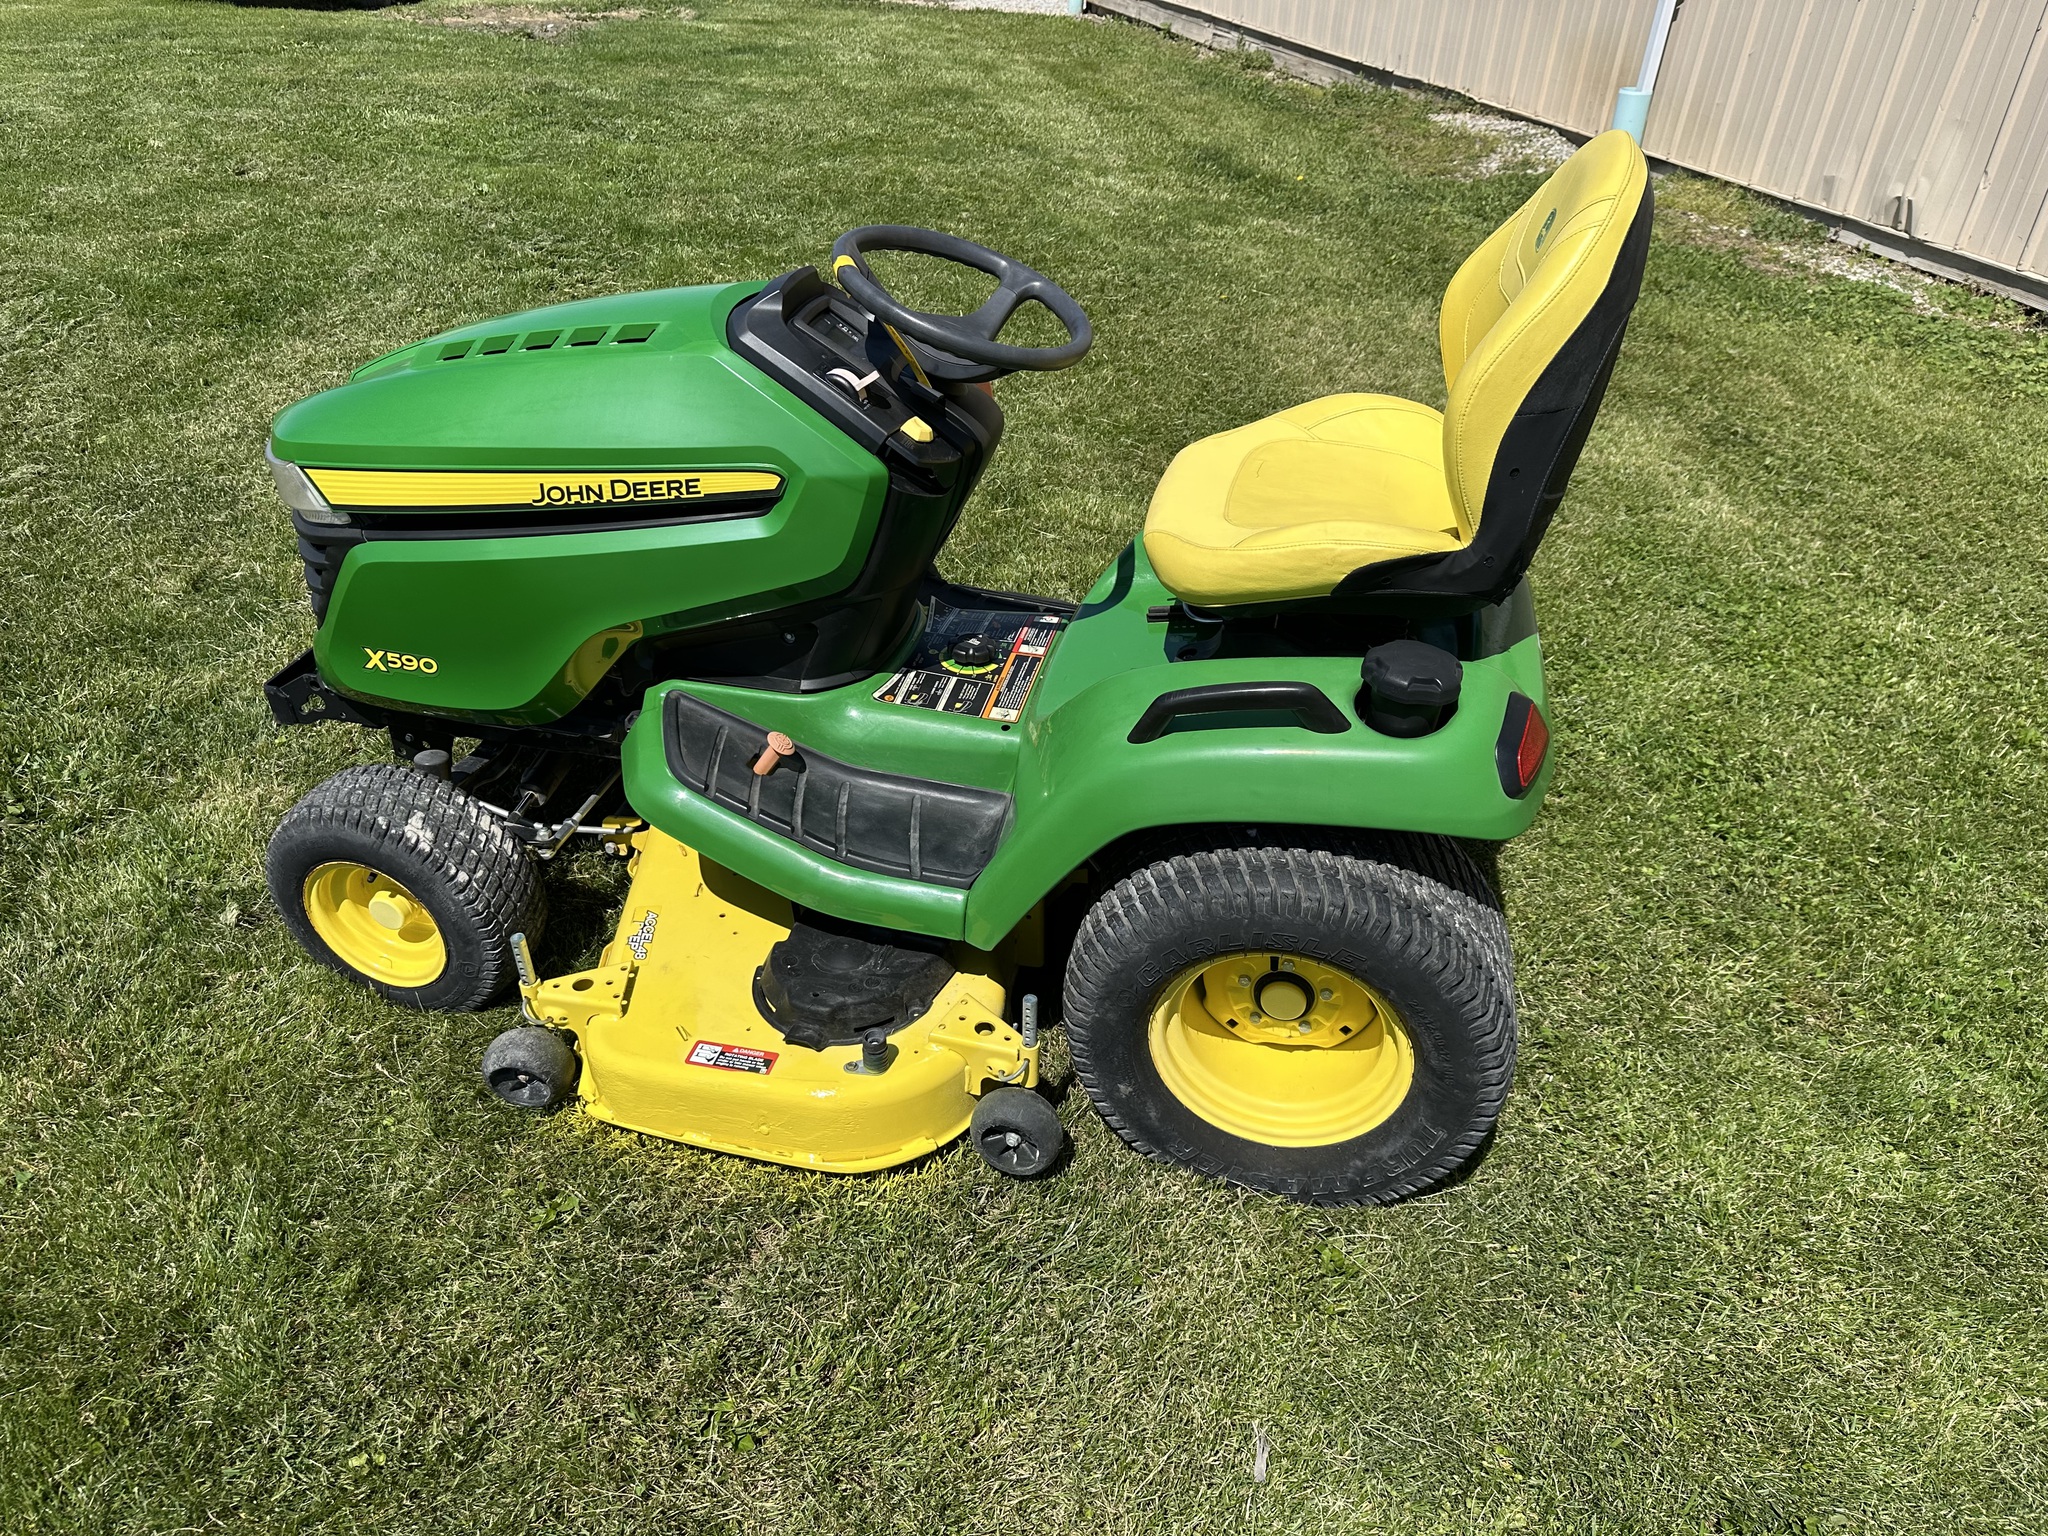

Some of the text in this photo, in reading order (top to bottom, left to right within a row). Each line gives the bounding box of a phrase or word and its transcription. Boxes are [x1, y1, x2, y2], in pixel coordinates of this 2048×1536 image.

[532, 478, 701, 504] JOHN DEERE
[361, 647, 438, 674] X590
[1135, 932, 1368, 988] CARLISLE
[739, 1048, 765, 1057] DANGER
